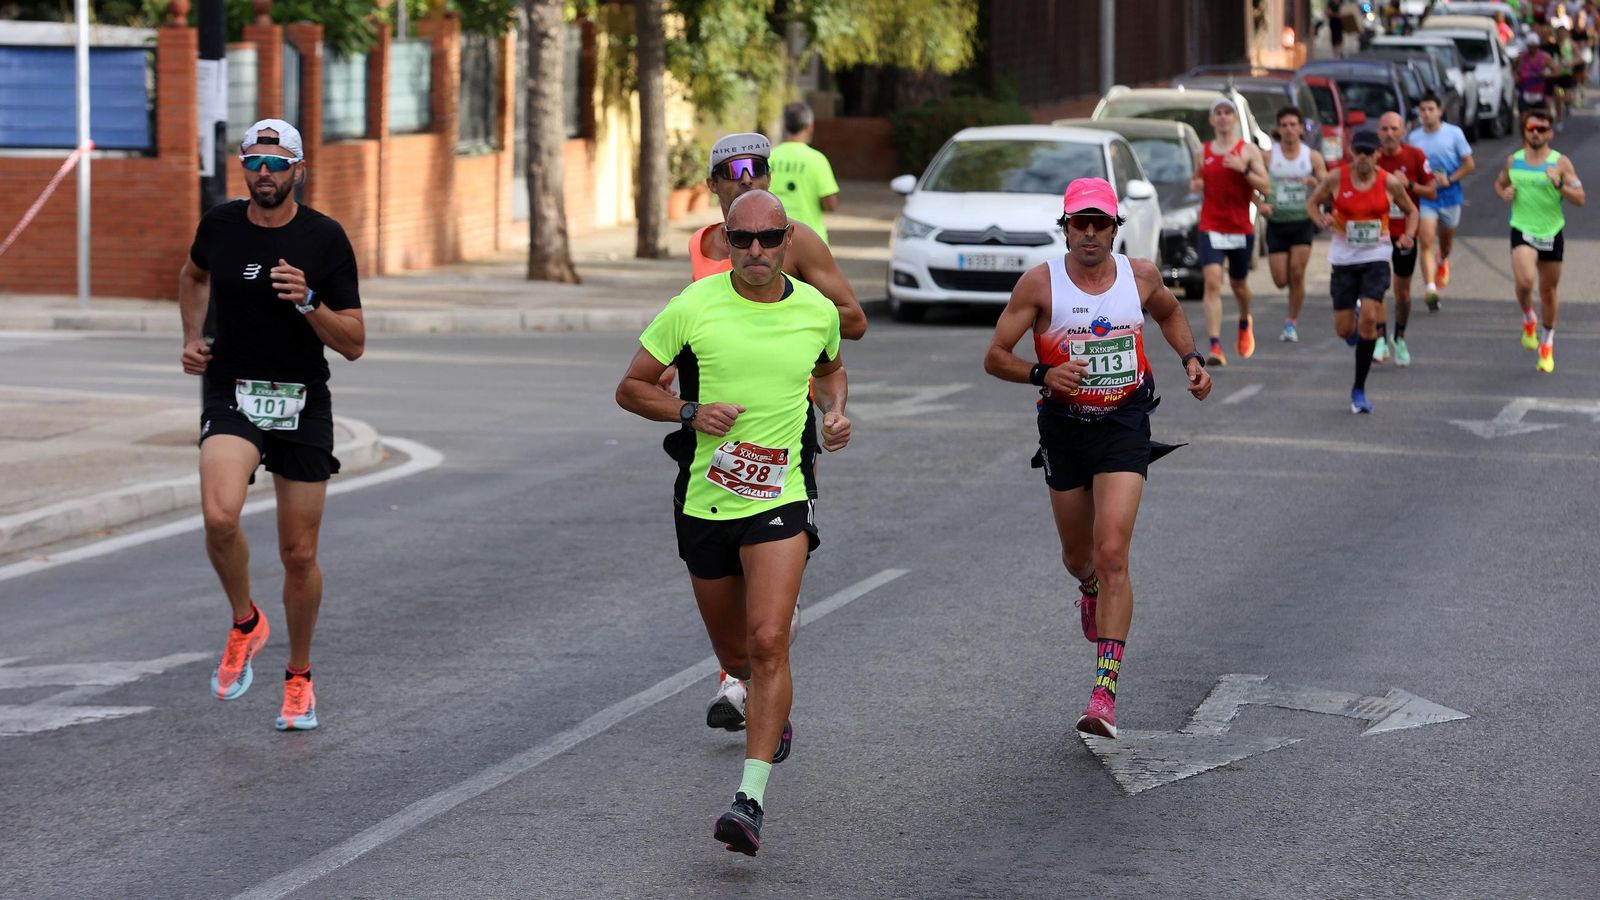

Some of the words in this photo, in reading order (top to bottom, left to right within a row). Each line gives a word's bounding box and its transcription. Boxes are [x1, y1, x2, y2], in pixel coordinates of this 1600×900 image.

[712, 147, 737, 155] NIKE
[742, 142, 770, 151] TRAIL
[1088, 354, 1123, 373] 113
[1081, 386, 1124, 395] FITNESS
[254, 398, 286, 416] 101
[730, 459, 771, 483] 298
